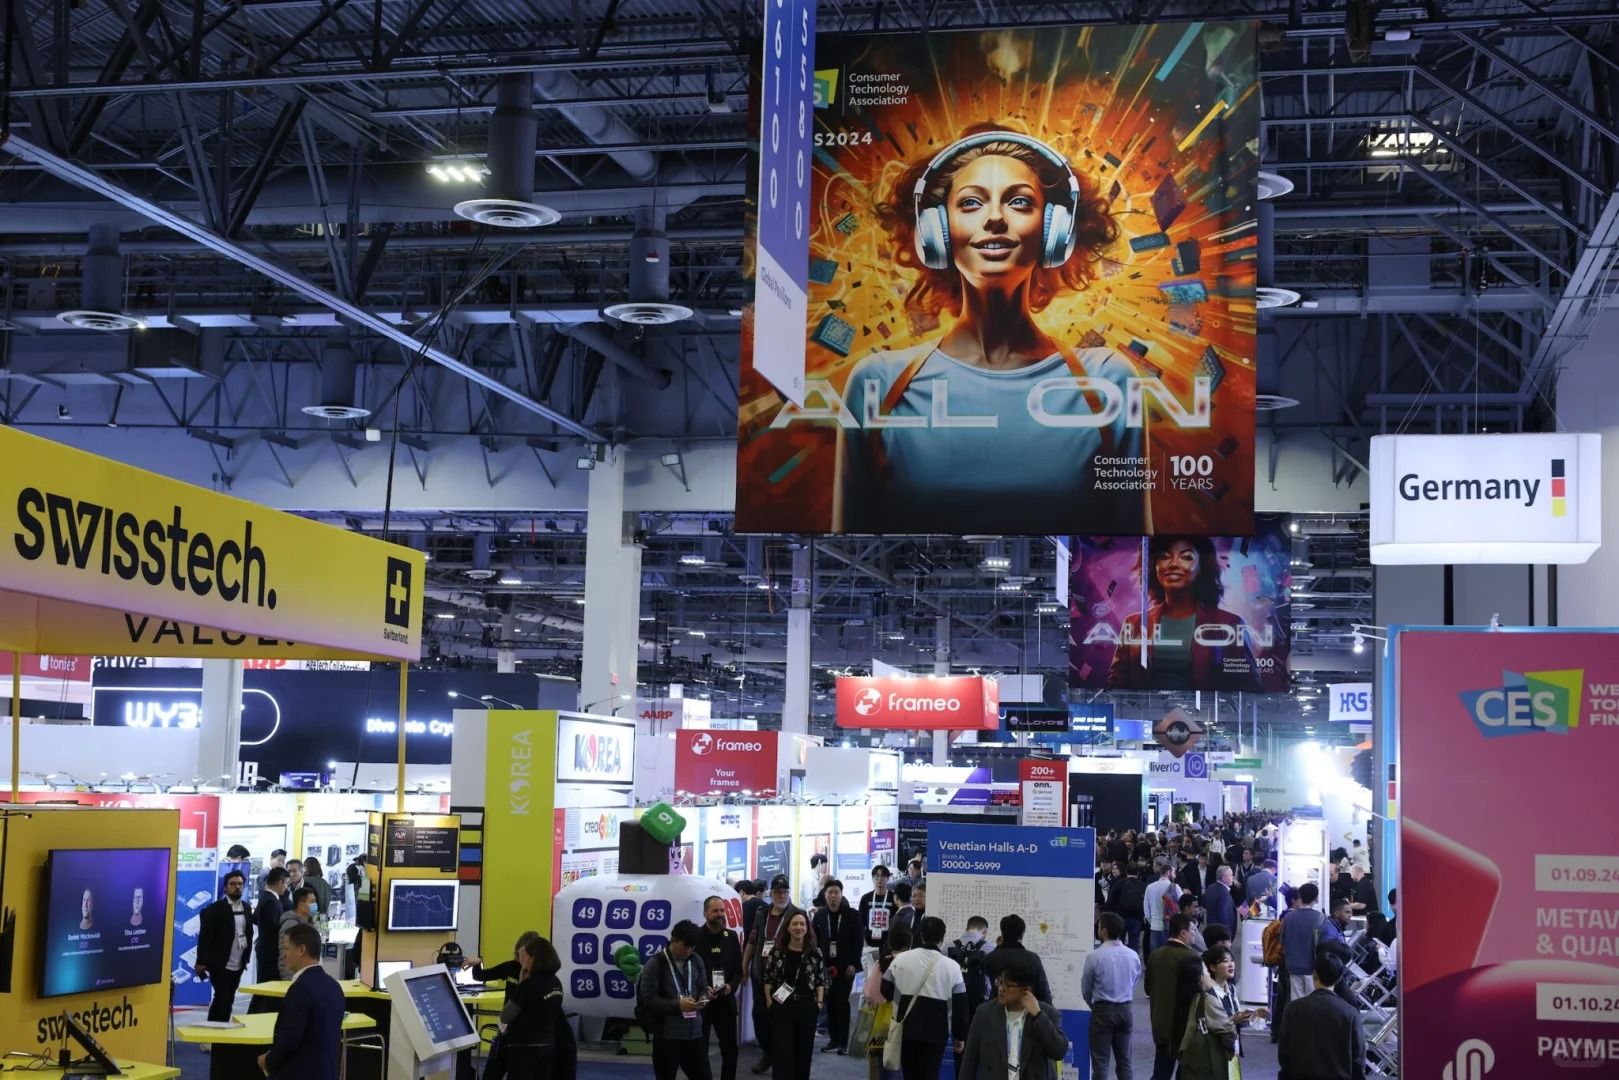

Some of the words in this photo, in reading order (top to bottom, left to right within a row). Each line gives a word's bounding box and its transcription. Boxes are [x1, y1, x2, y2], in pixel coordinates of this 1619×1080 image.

[849, 73, 901, 82] Consumer
[849, 84, 909, 94] Technology
[849, 96, 908, 106] Association
[769, 378, 998, 429] ALL
[1026, 375, 1212, 429] ON
[1094, 456, 1148, 465] Consumer
[1170, 455, 1213, 476] 100
[1094, 467, 1158, 479] Technology
[1094, 480, 1156, 490] Association
[1170, 478, 1213, 490] YEARS
[1399, 473, 1540, 507] Germany
[14, 487, 277, 610] swisstech.
[1082, 622, 1182, 646] ALL
[1194, 622, 1273, 647] ON
[1255, 657, 1274, 668] 100
[888, 693, 960, 711] frameo
[1589, 699, 1619, 711] TO
[1476, 690, 1557, 727] CES
[642, 710, 673, 720] AARP
[404, 720, 426, 733] nto
[716, 738, 762, 752] frameo
[715, 768, 735, 777] Your
[1031, 766, 1055, 775] 200+
[710, 777, 740, 787] frames
[939, 840, 986, 852] Venetian
[989, 843, 1014, 853] Halls
[1017, 843, 1038, 854] A-D
[942, 860, 1001, 871] 50000-56999
[578, 906, 595, 919] 49
[612, 907, 629, 920] 56
[647, 908, 665, 921] 63
[577, 942, 593, 955] 16
[1536, 933, 1553, 954] &
[1561, 934, 1619, 958] QUA
[577, 979, 594, 991] 28
[611, 979, 628, 992] 32
